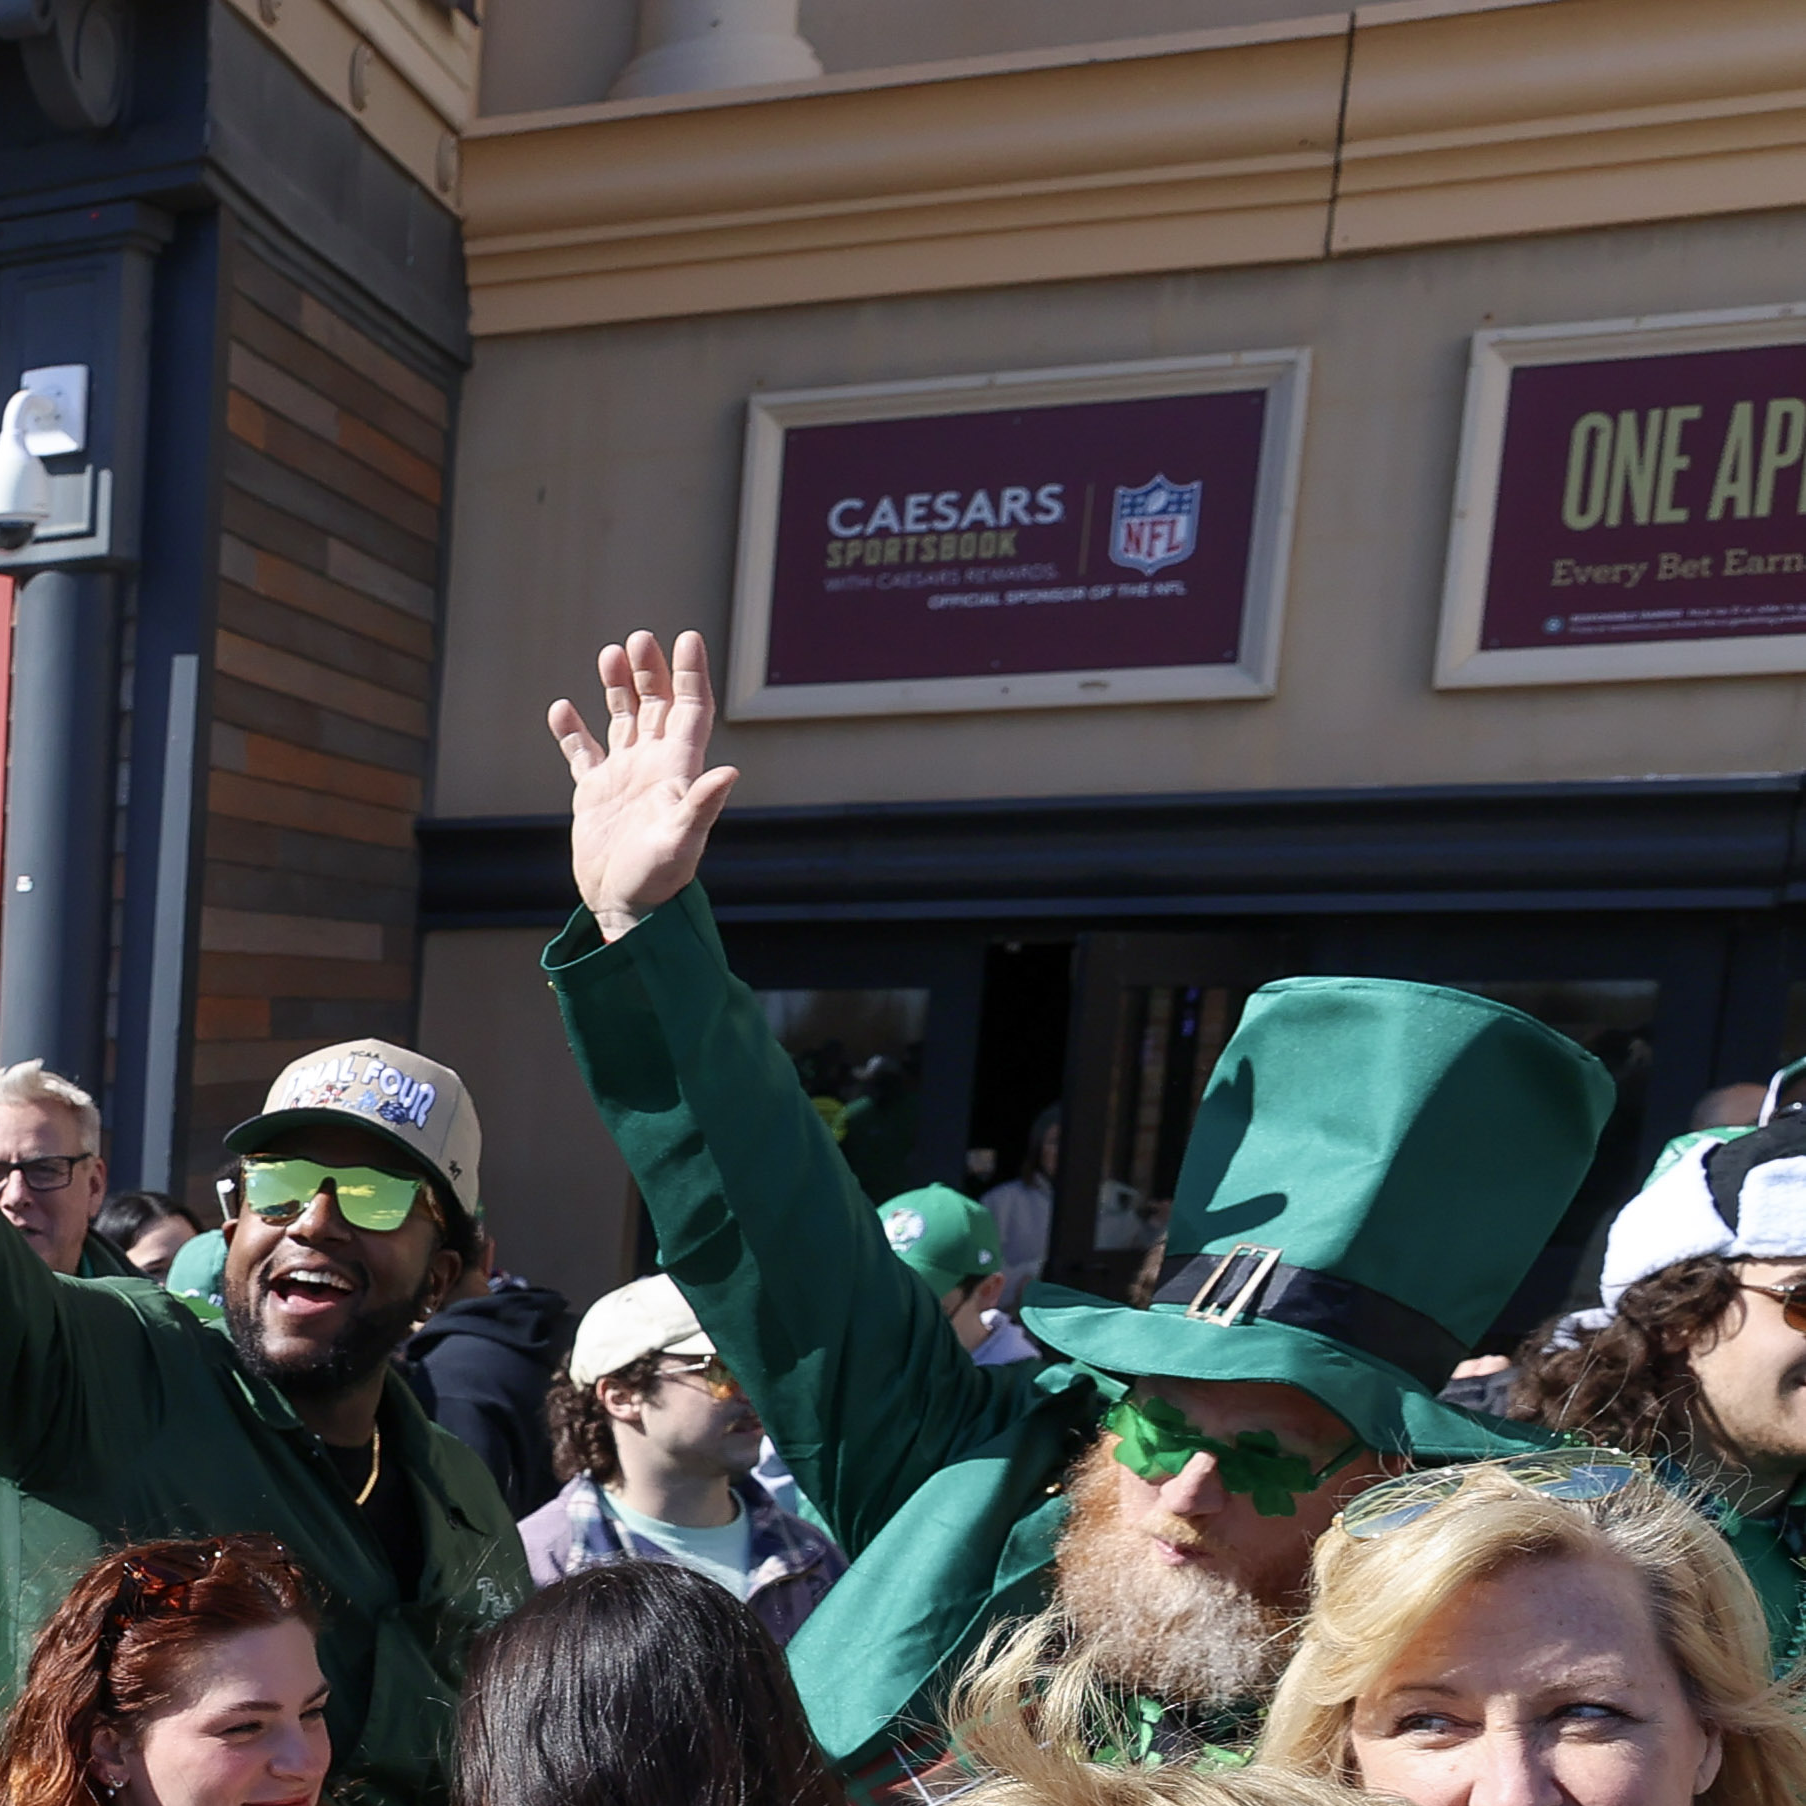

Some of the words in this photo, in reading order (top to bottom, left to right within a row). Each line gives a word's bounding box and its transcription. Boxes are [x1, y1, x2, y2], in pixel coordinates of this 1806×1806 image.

[1562, 404, 1703, 531] ONE
[1706, 397, 1806, 521] AP
[827, 483, 1065, 538] CAESARS
[825, 530, 1018, 568] SPORTSBOOK
[1123, 519, 1183, 558] NFL
[823, 575, 873, 592] WITH
[876, 569, 962, 590] CAESARS
[964, 562, 1059, 584] REWARDS
[1550, 557, 1649, 588] Every
[1656, 552, 1713, 581] Bet
[1722, 548, 1806, 576] Earn
[927, 592, 1001, 610] OFFICIAL
[1004, 587, 1087, 605] SPONSOR
[1117, 581, 1149, 598] THE
[286, 1056, 356, 1099] FINAL
[362, 1058, 436, 1129] FOUR
